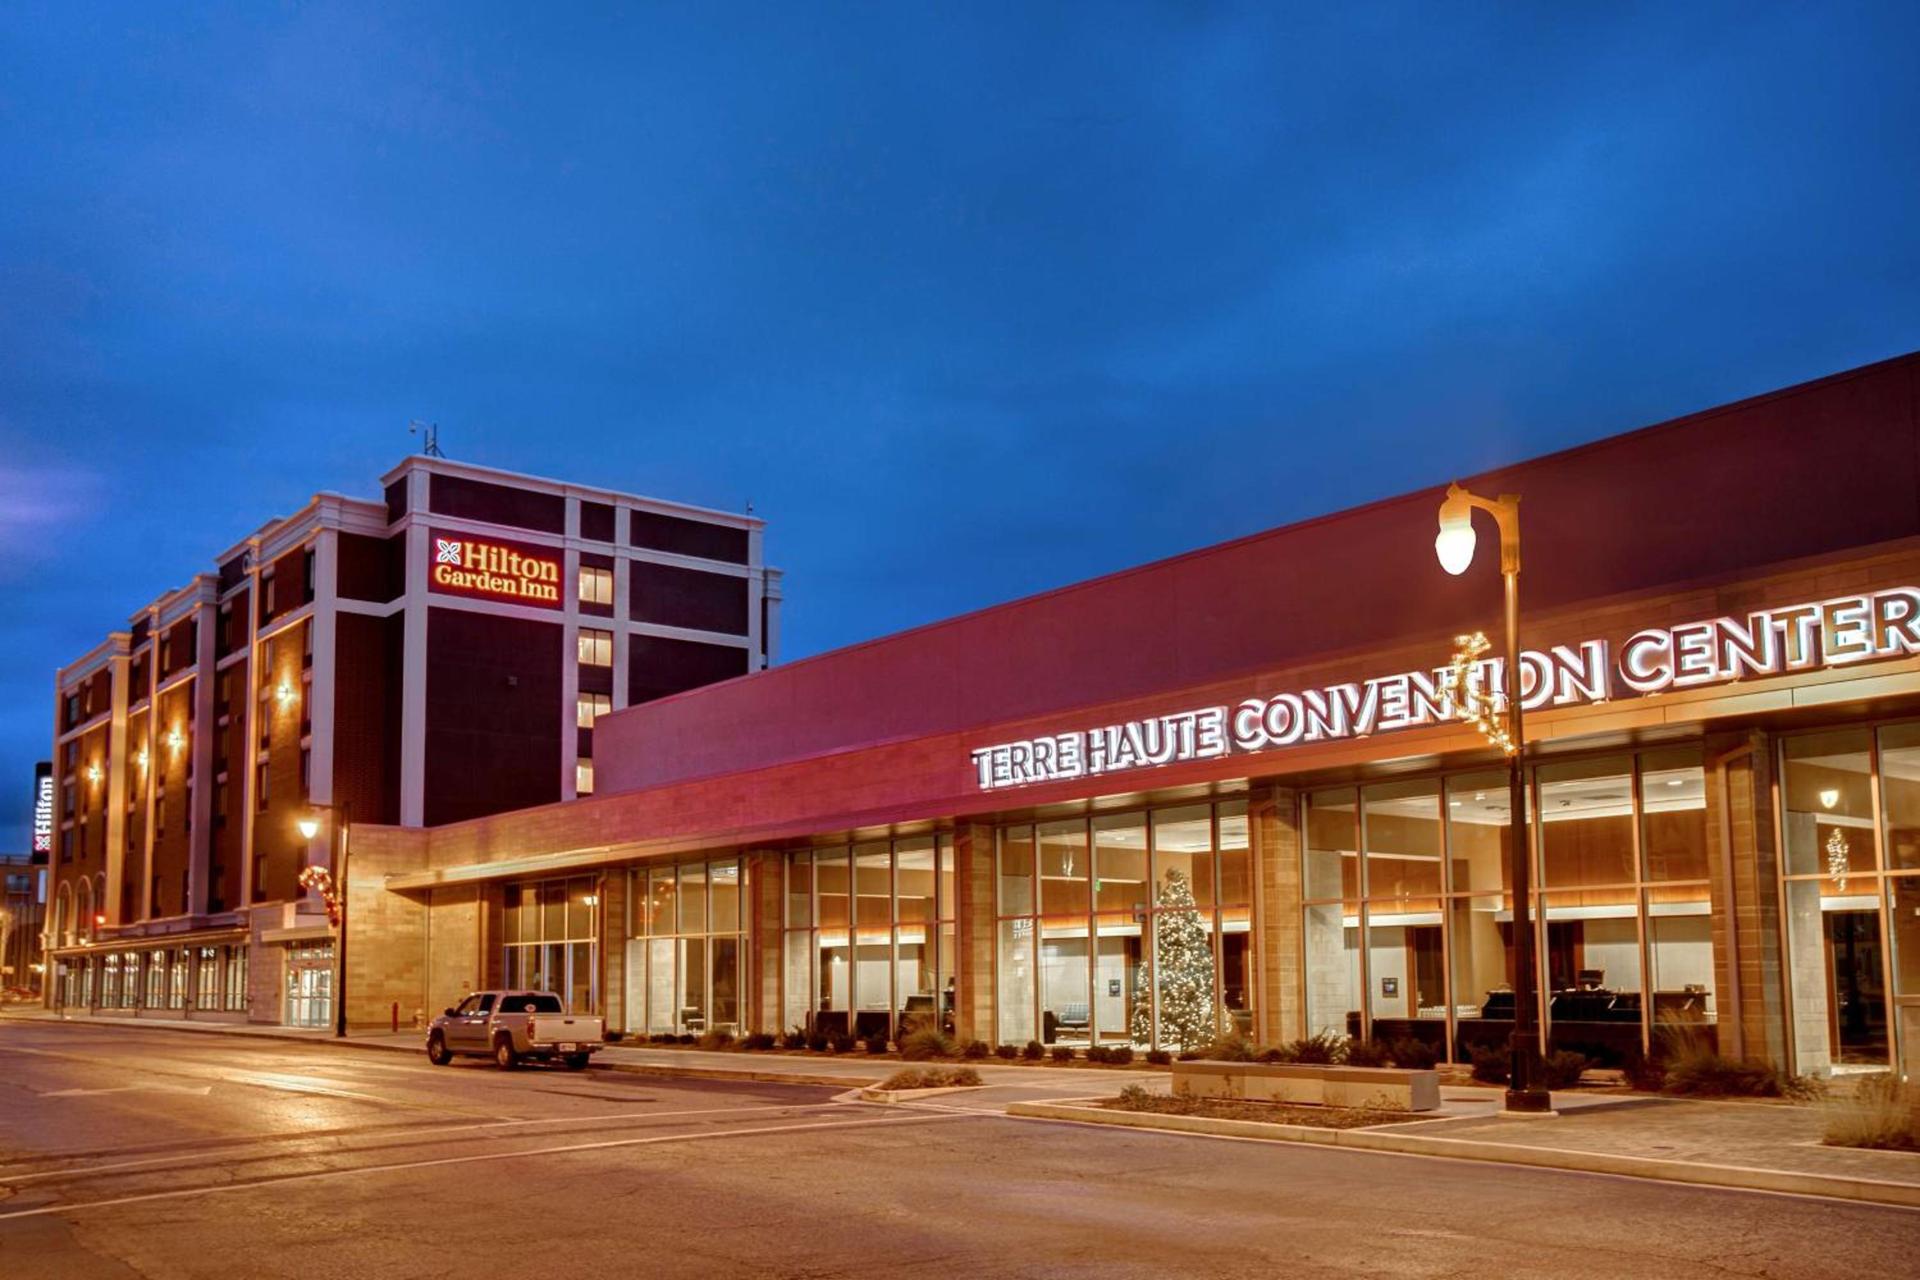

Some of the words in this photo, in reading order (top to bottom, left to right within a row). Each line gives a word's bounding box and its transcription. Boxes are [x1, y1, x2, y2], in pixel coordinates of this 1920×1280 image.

[435, 565, 517, 594] Garden
[520, 577, 558, 600] Inn
[464, 542, 558, 581] Hilton
[971, 732, 1086, 791] TERRE
[1088, 705, 1229, 774] HAUTE
[1231, 639, 1609, 749] CONVENTION
[1619, 586, 1920, 693] CENTER
[35, 776, 53, 835] Hilton
